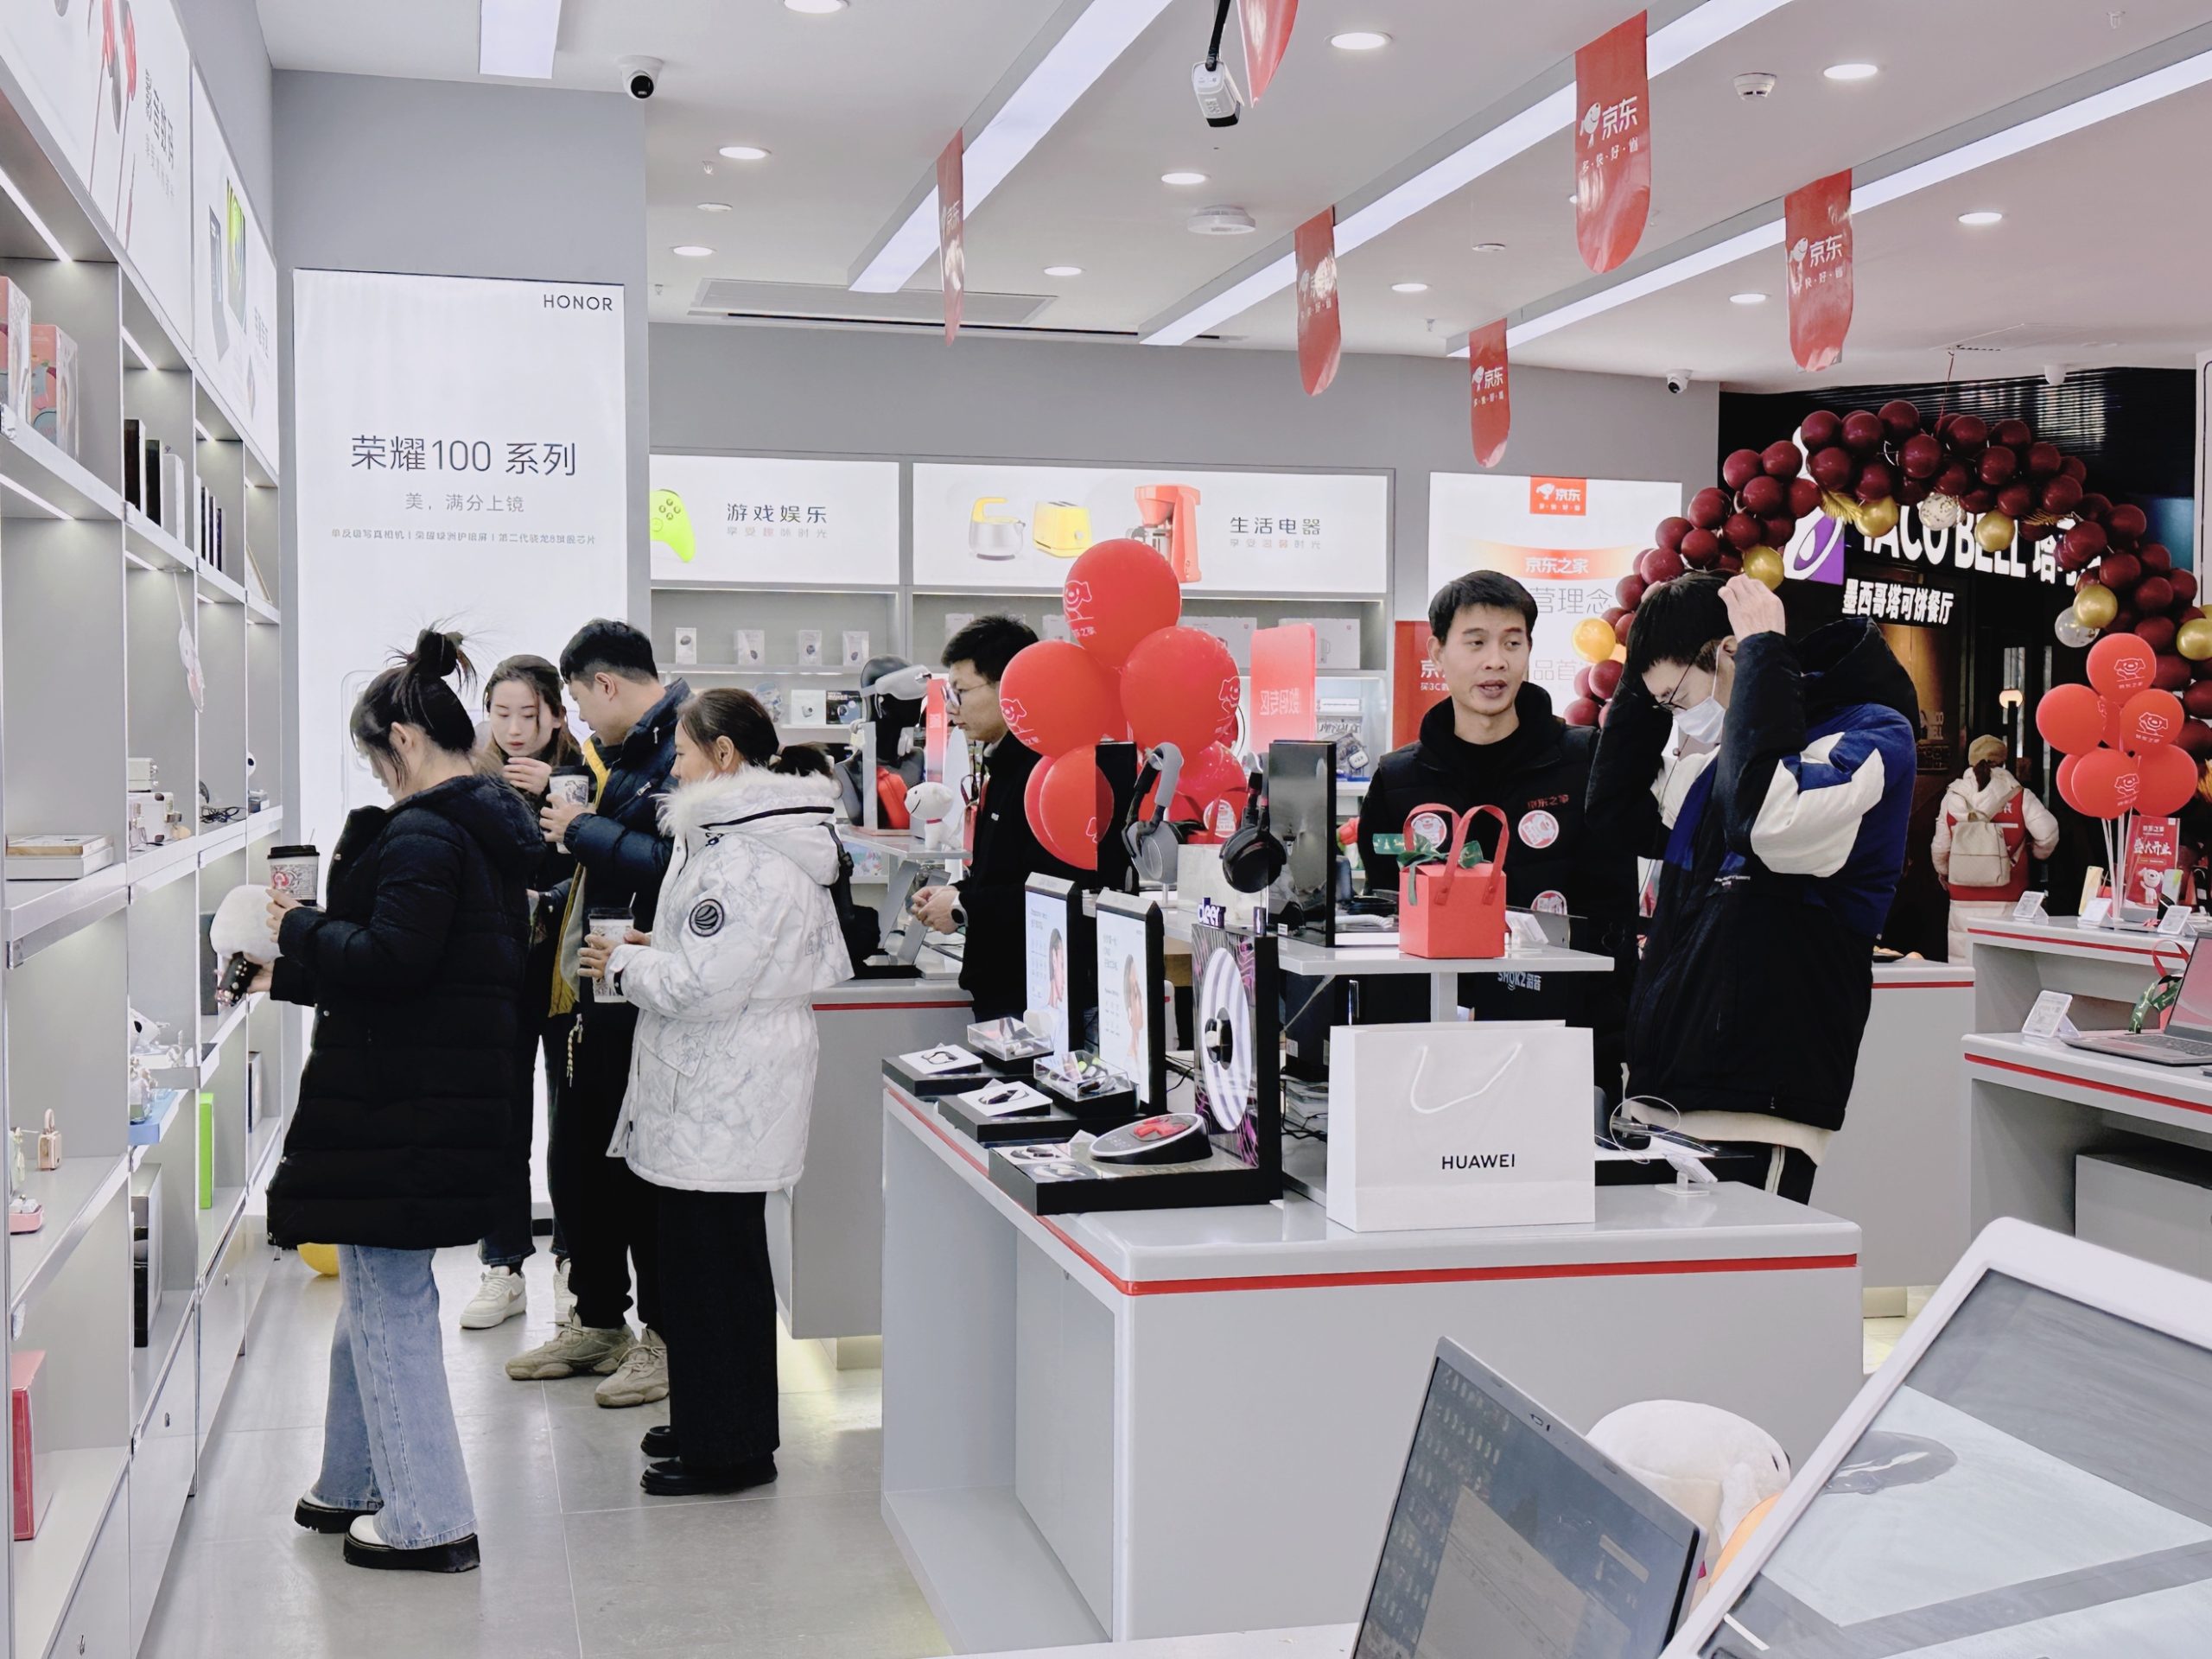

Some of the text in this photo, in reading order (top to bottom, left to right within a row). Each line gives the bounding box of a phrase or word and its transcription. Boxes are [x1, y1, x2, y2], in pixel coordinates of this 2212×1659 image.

[1602, 96, 1637, 140] 京东
[1810, 234, 1842, 268] 京东
[543, 294, 613, 311] HONOR
[1484, 366, 1503, 389] 京东
[352, 435, 575, 476] 荣耀100 系列
[1556, 488, 1581, 501] 京东
[728, 503, 827, 524] 游戏娱乐
[1230, 517, 1320, 535] 生活电器
[1525, 556, 1589, 574] 京东之家
[1841, 578, 1954, 625] 墨西哥塔可饼餐厅
[1442, 1154, 1515, 1169] HUAWEI
